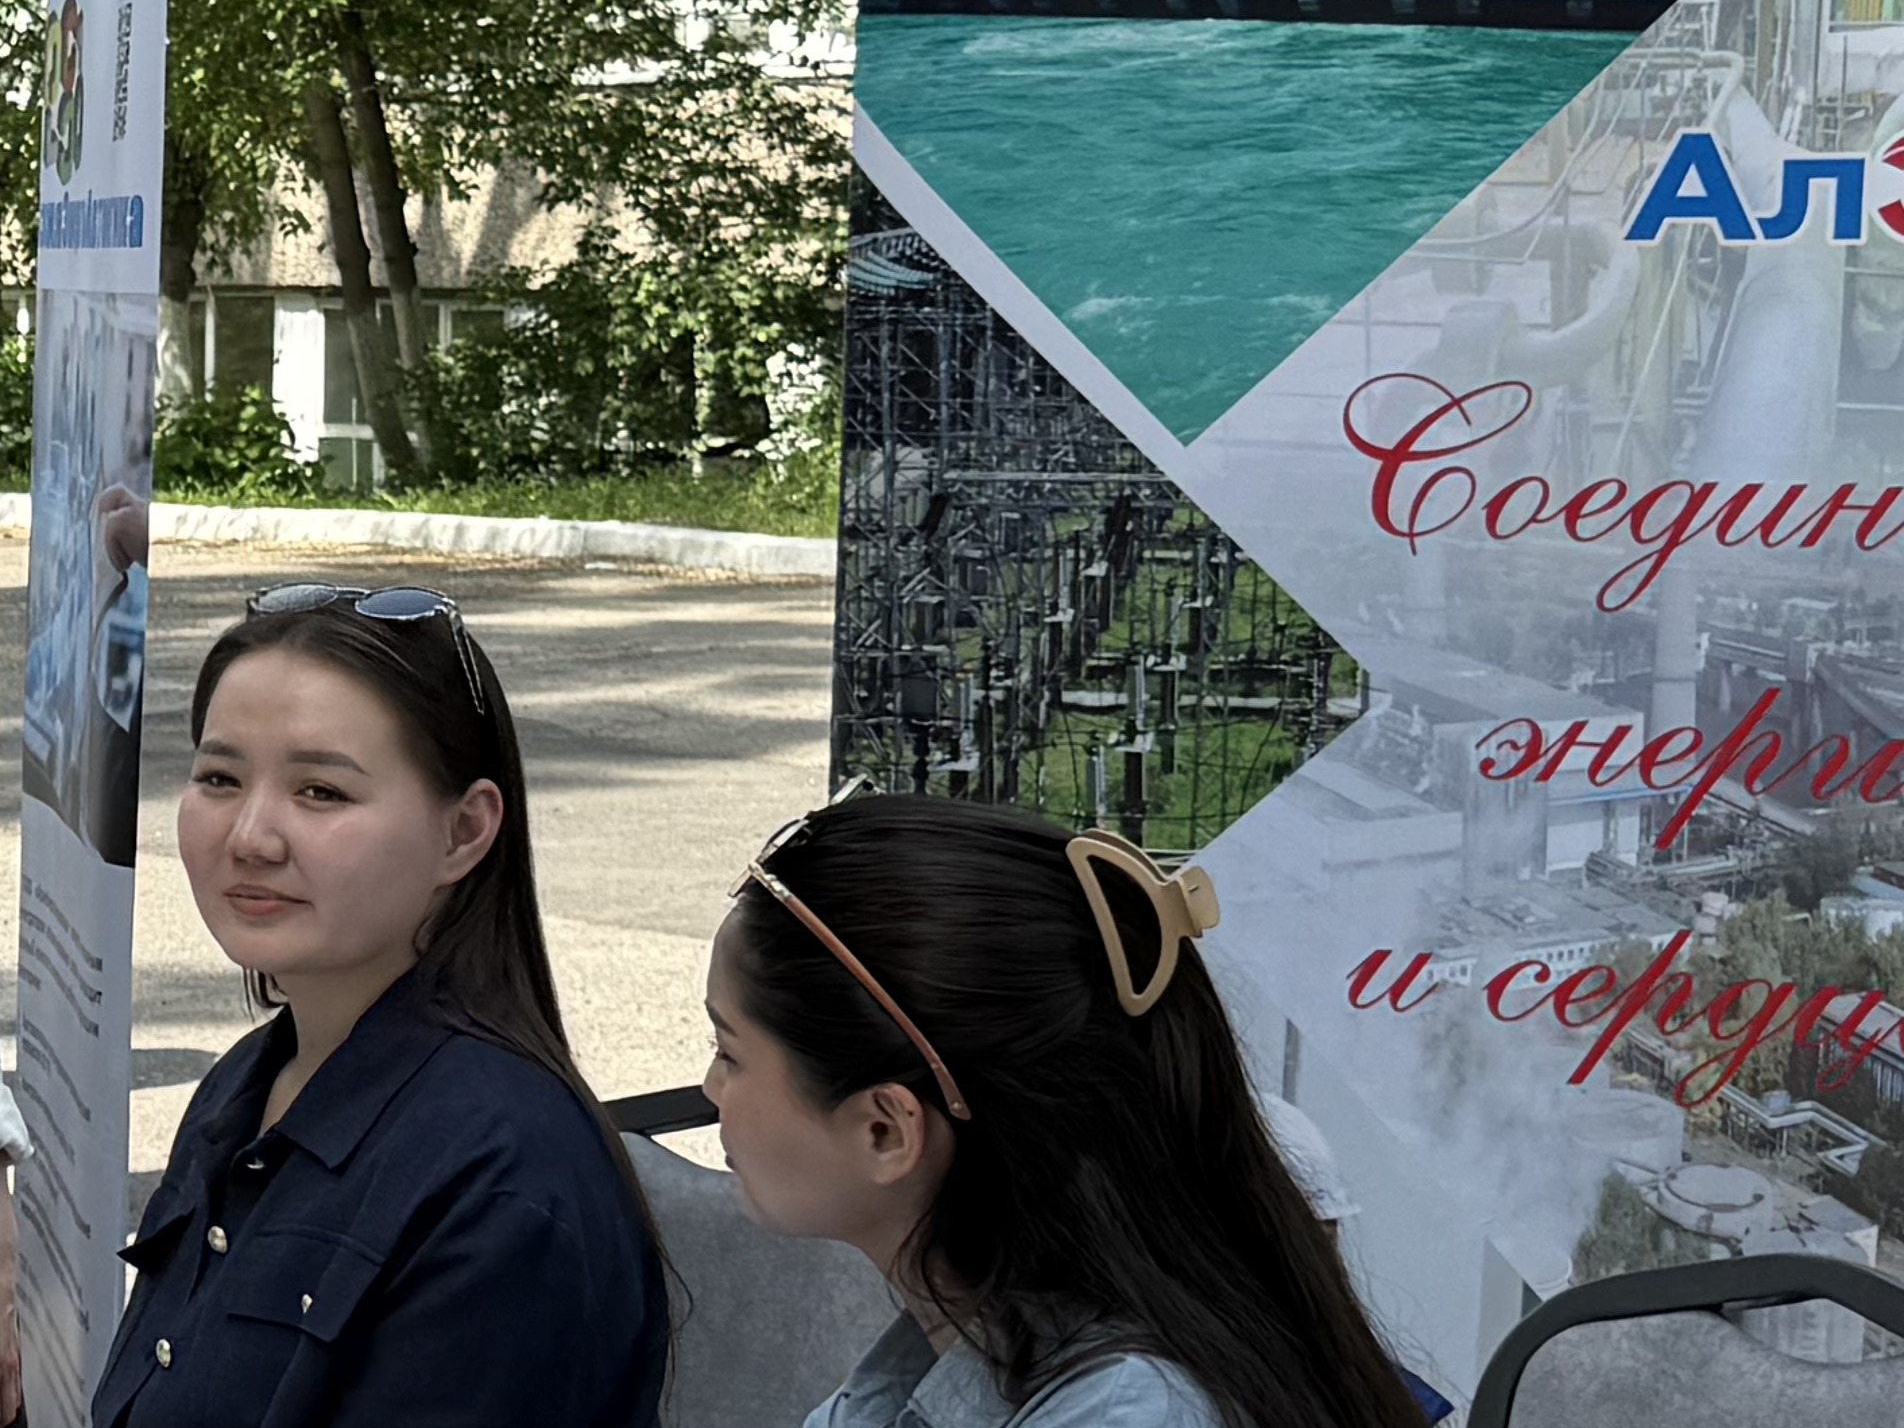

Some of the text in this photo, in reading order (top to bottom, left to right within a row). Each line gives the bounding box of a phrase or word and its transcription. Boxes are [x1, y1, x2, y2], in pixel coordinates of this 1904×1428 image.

[1624, 133, 1904, 240] Ал
[1347, 930, 1904, 1109] и сердц
